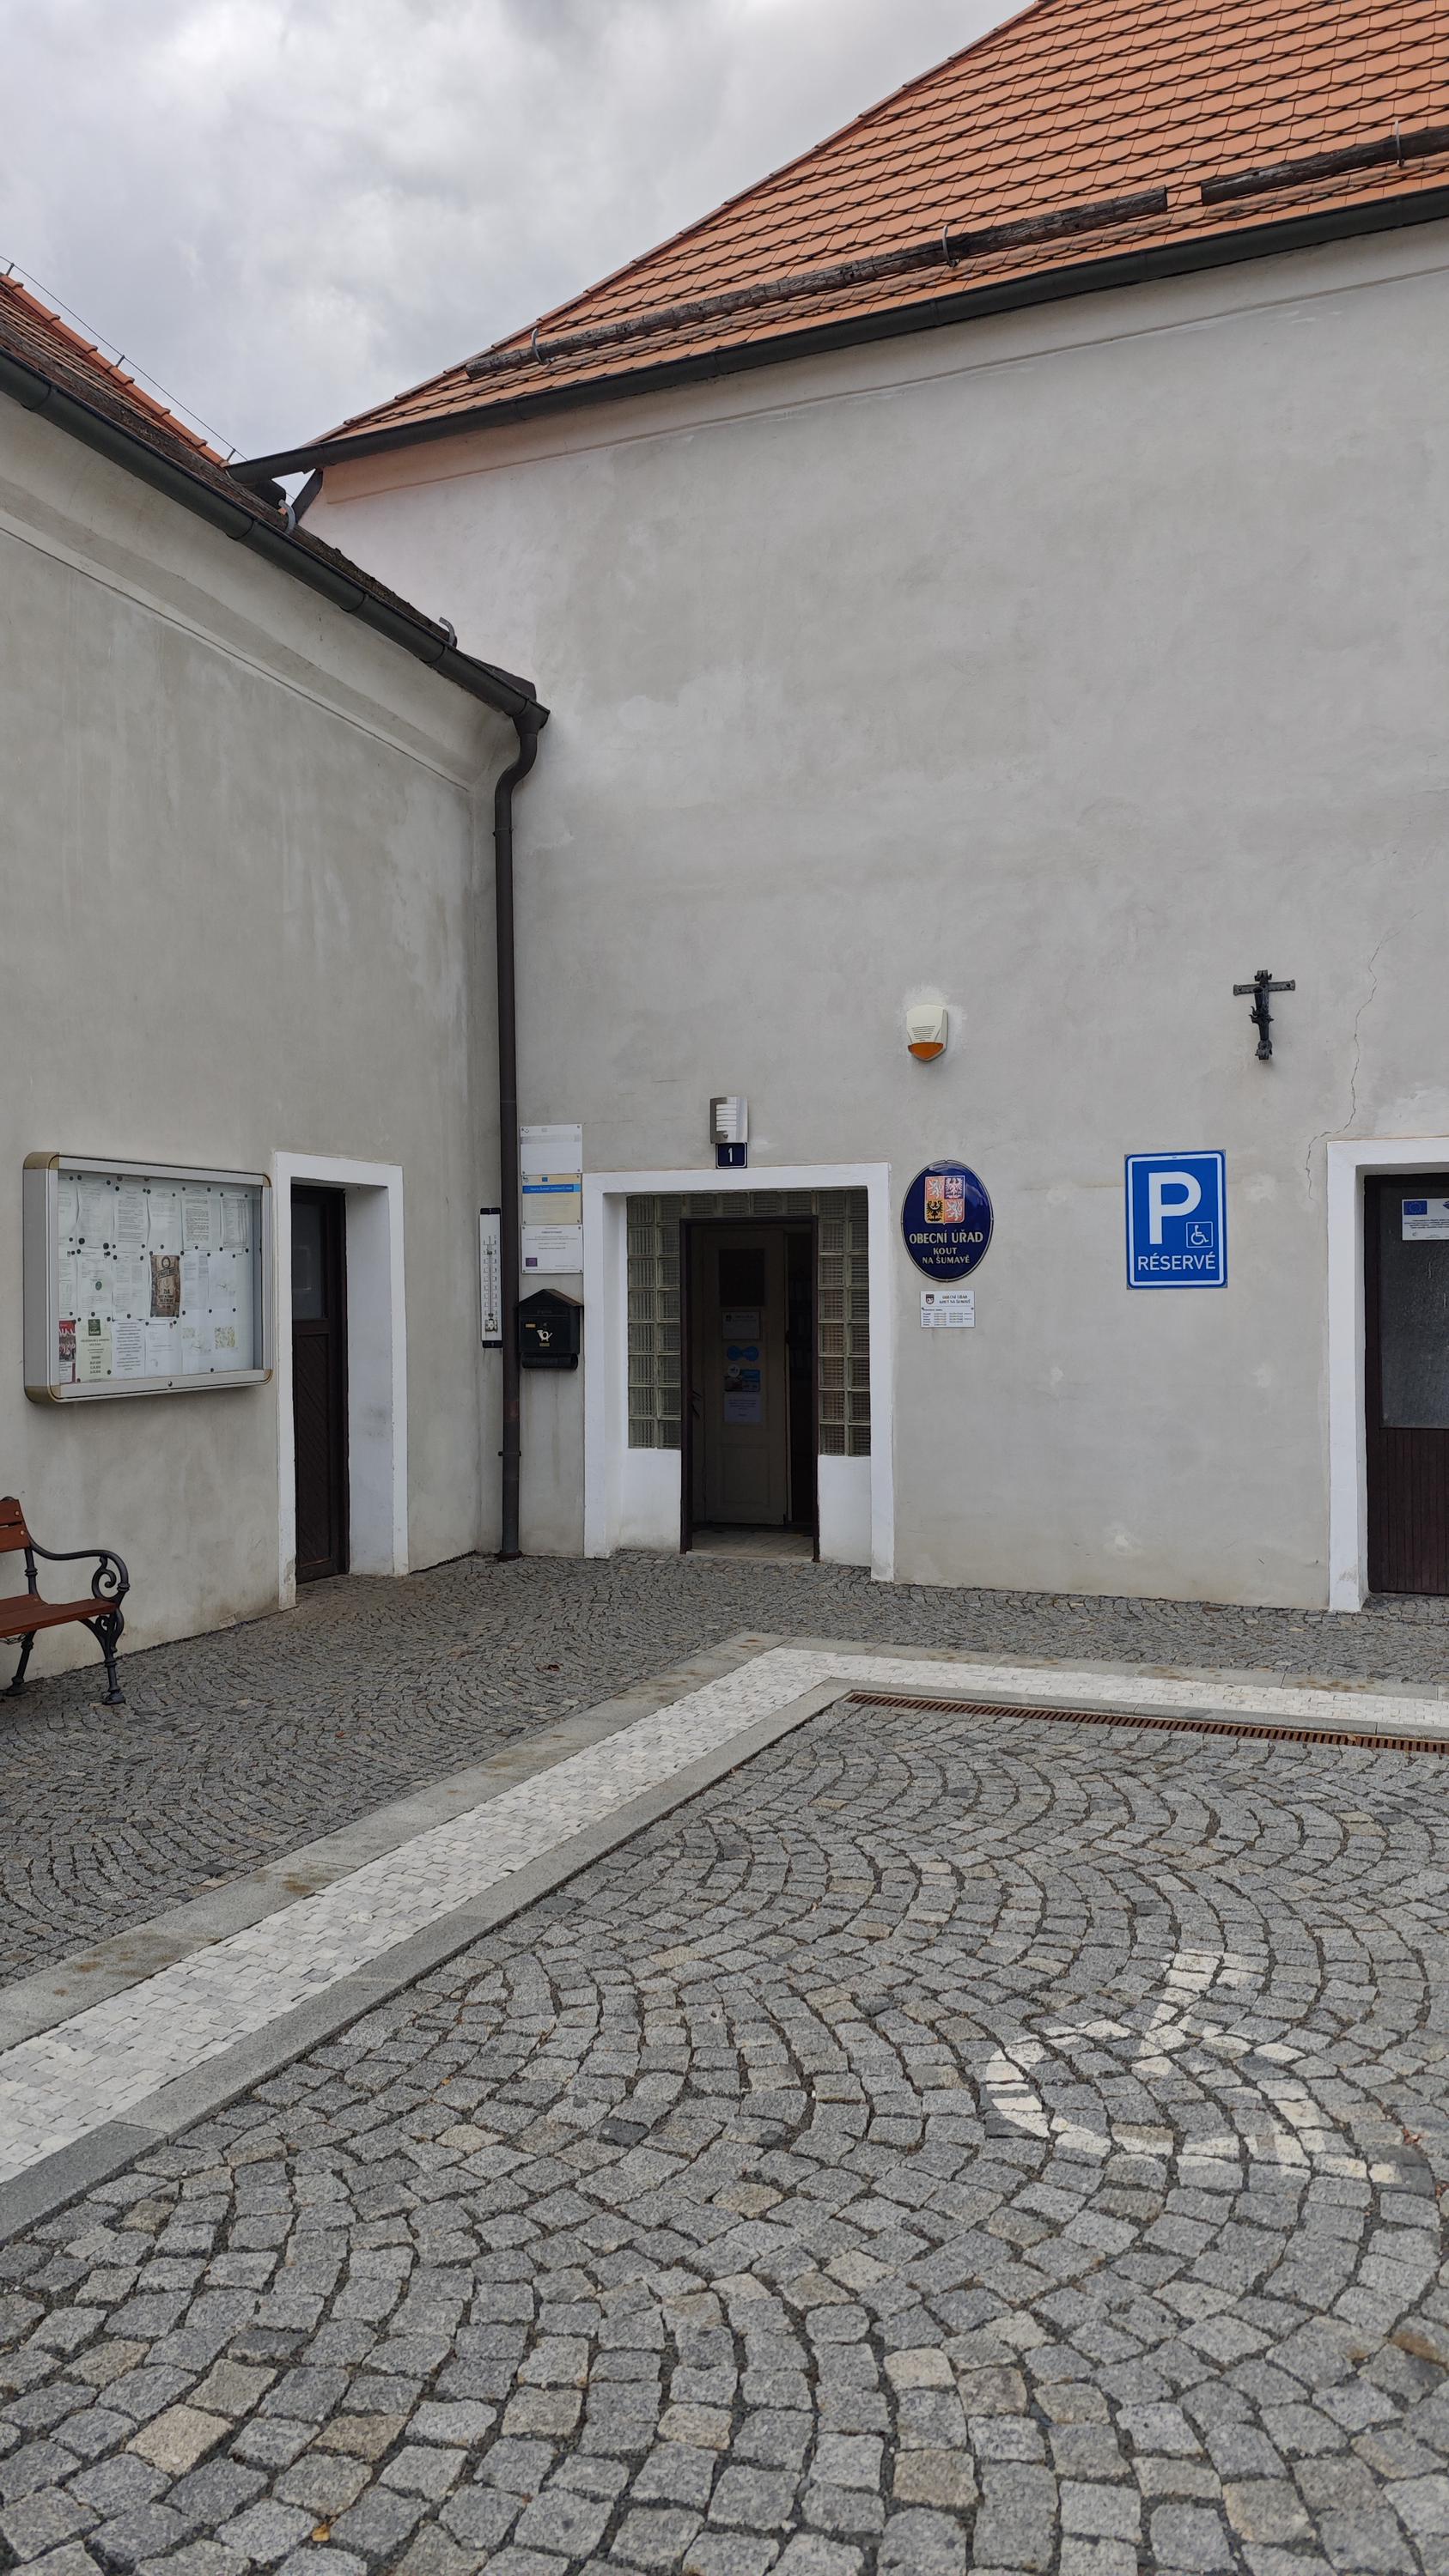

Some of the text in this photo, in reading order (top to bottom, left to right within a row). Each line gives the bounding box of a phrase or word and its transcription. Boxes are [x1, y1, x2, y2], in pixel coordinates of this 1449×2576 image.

[728, 1147, 734, 1163] 1
[1148, 1171, 1202, 1244] P
[910, 1229, 983, 1244] OBECNÍ ÚŘAD
[933, 1247, 958, 1255] KOUT
[922, 1255, 971, 1265] NA ŠUMAVĚ
[1138, 1251, 1216, 1271] RÉSERVÉ
